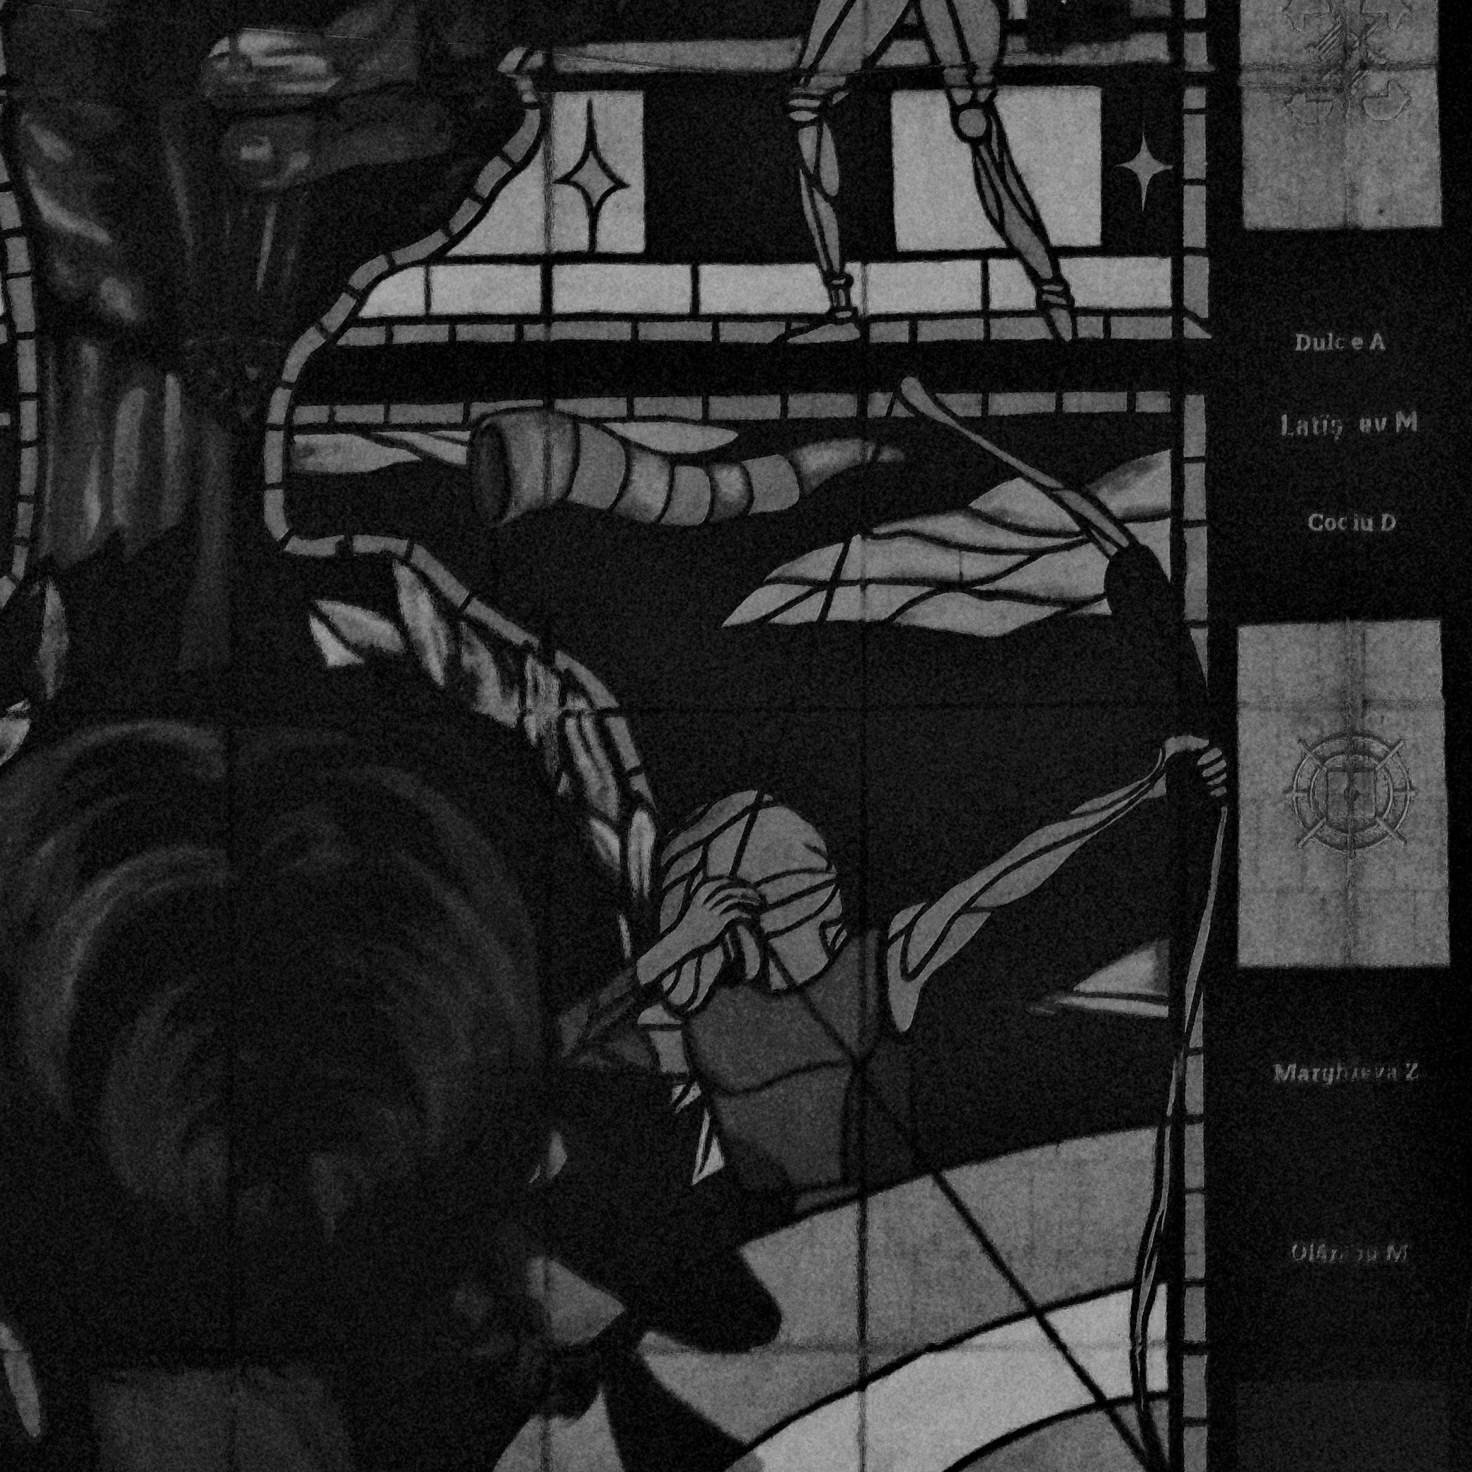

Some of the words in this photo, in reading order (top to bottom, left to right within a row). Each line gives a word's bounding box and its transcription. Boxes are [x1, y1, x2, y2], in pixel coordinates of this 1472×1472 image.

[1369, 332, 1386, 351] A
[1395, 410, 1418, 433] M
[1381, 513, 1397, 532] D
